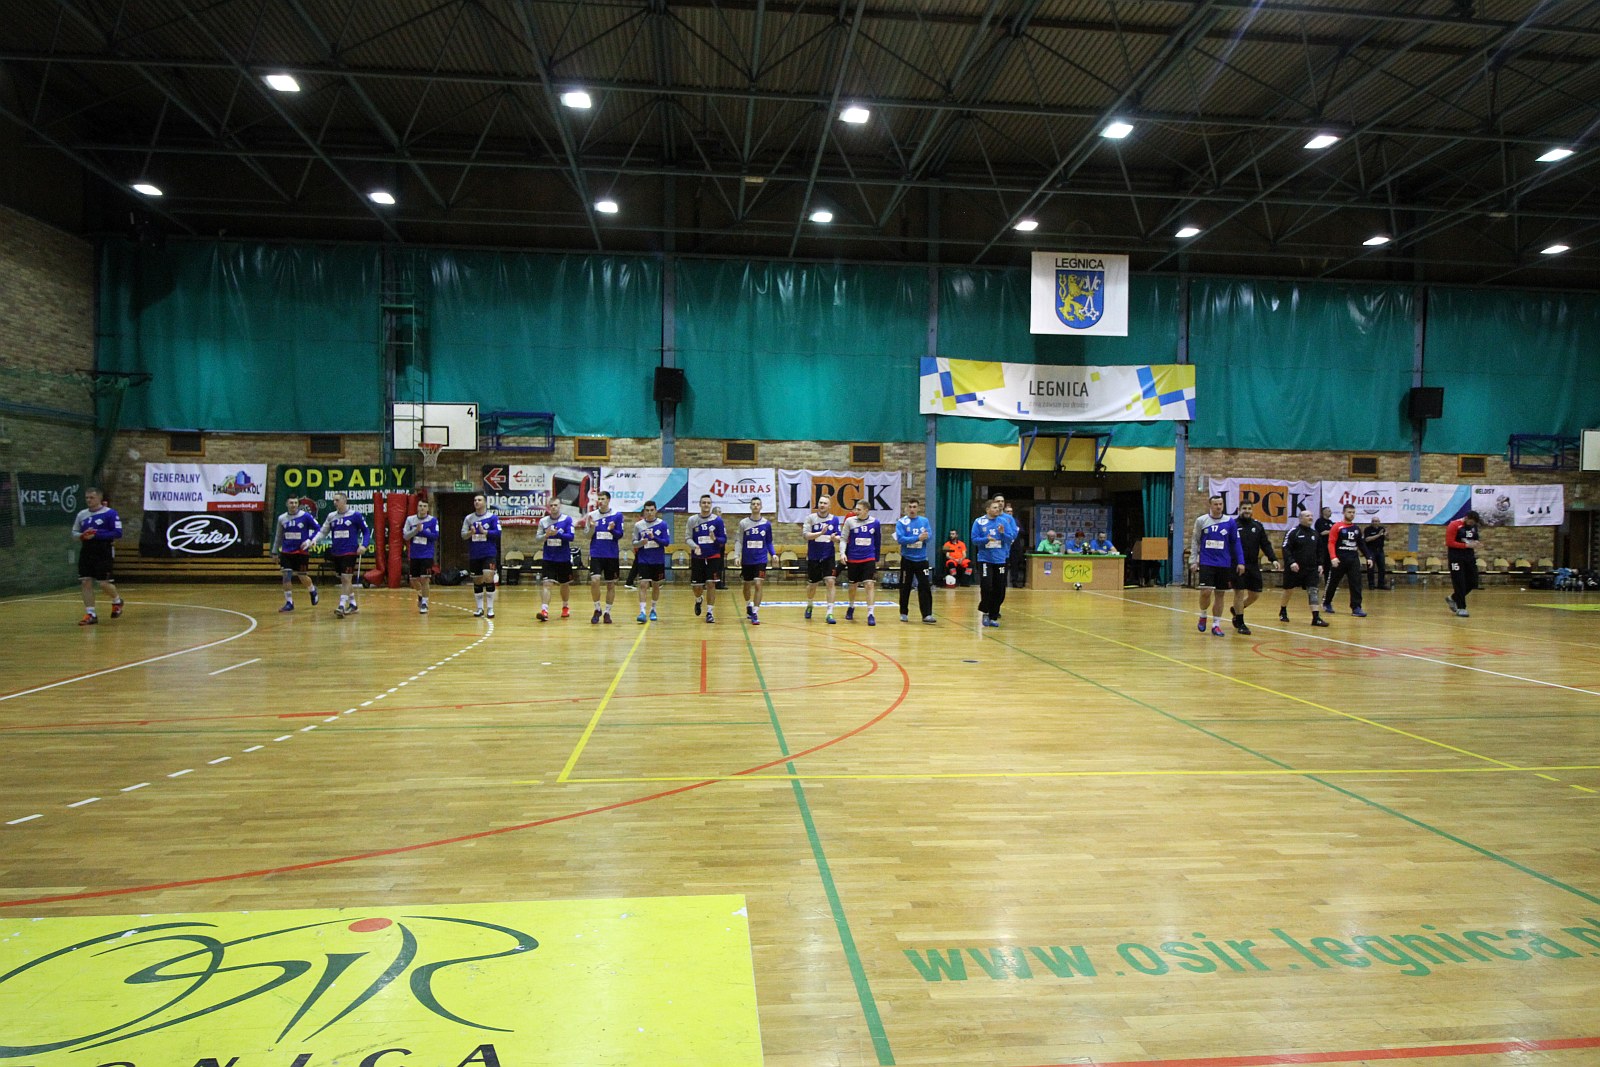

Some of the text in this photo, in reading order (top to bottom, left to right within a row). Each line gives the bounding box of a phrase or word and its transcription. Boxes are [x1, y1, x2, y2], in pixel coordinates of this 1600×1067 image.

[1055, 258, 1105, 269] LEGNICA
[1029, 380, 1089, 397] LEGNICA
[467, 407, 474, 417] 4
[152, 473, 201, 483] GENERALNY
[284, 467, 407, 487] ODPADY
[731, 484, 771, 494] HURAS
[149, 491, 203, 502] WYKONAWCA
[486, 493, 546, 509] pieczątki
[787, 483, 893, 511] LPGK
[1357, 496, 1393, 505] HURAS
[1218, 490, 1313, 518] LPGK
[168, 520, 234, 549] Gates
[1348, 532, 1355, 540] 12
[1451, 563, 1460, 571] 16
[902, 917, 1600, 982] www.osir.legnica.p
